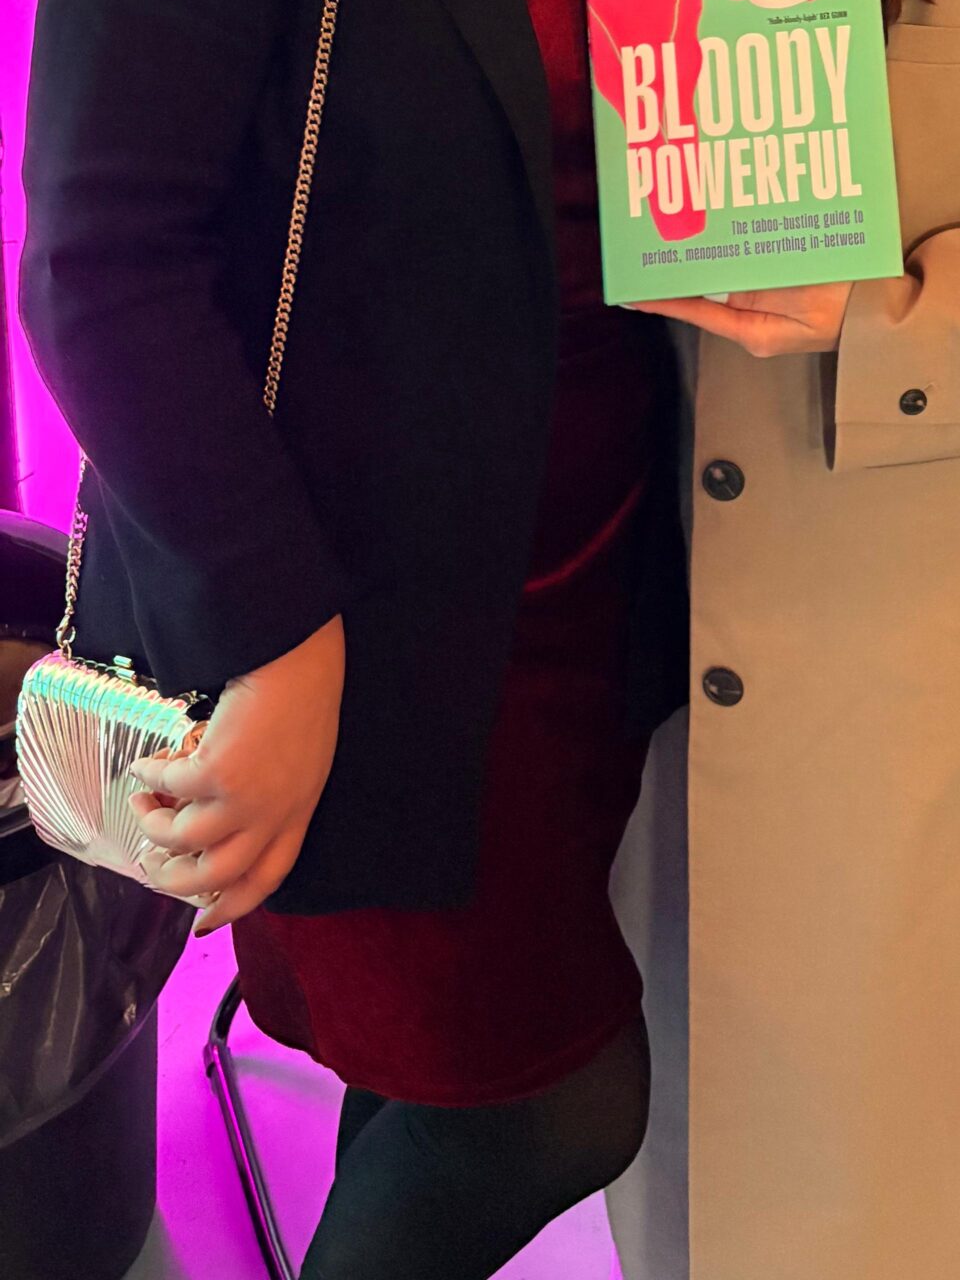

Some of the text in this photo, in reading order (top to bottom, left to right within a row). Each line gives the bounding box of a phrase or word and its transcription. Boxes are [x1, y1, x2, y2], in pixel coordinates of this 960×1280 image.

[621, 25, 851, 144] BLOODY
[626, 128, 862, 218] POWERFUL
[641, 231, 865, 269] periods, menopause & everything in-between
[731, 209, 865, 236] The taboo-busting guide to
